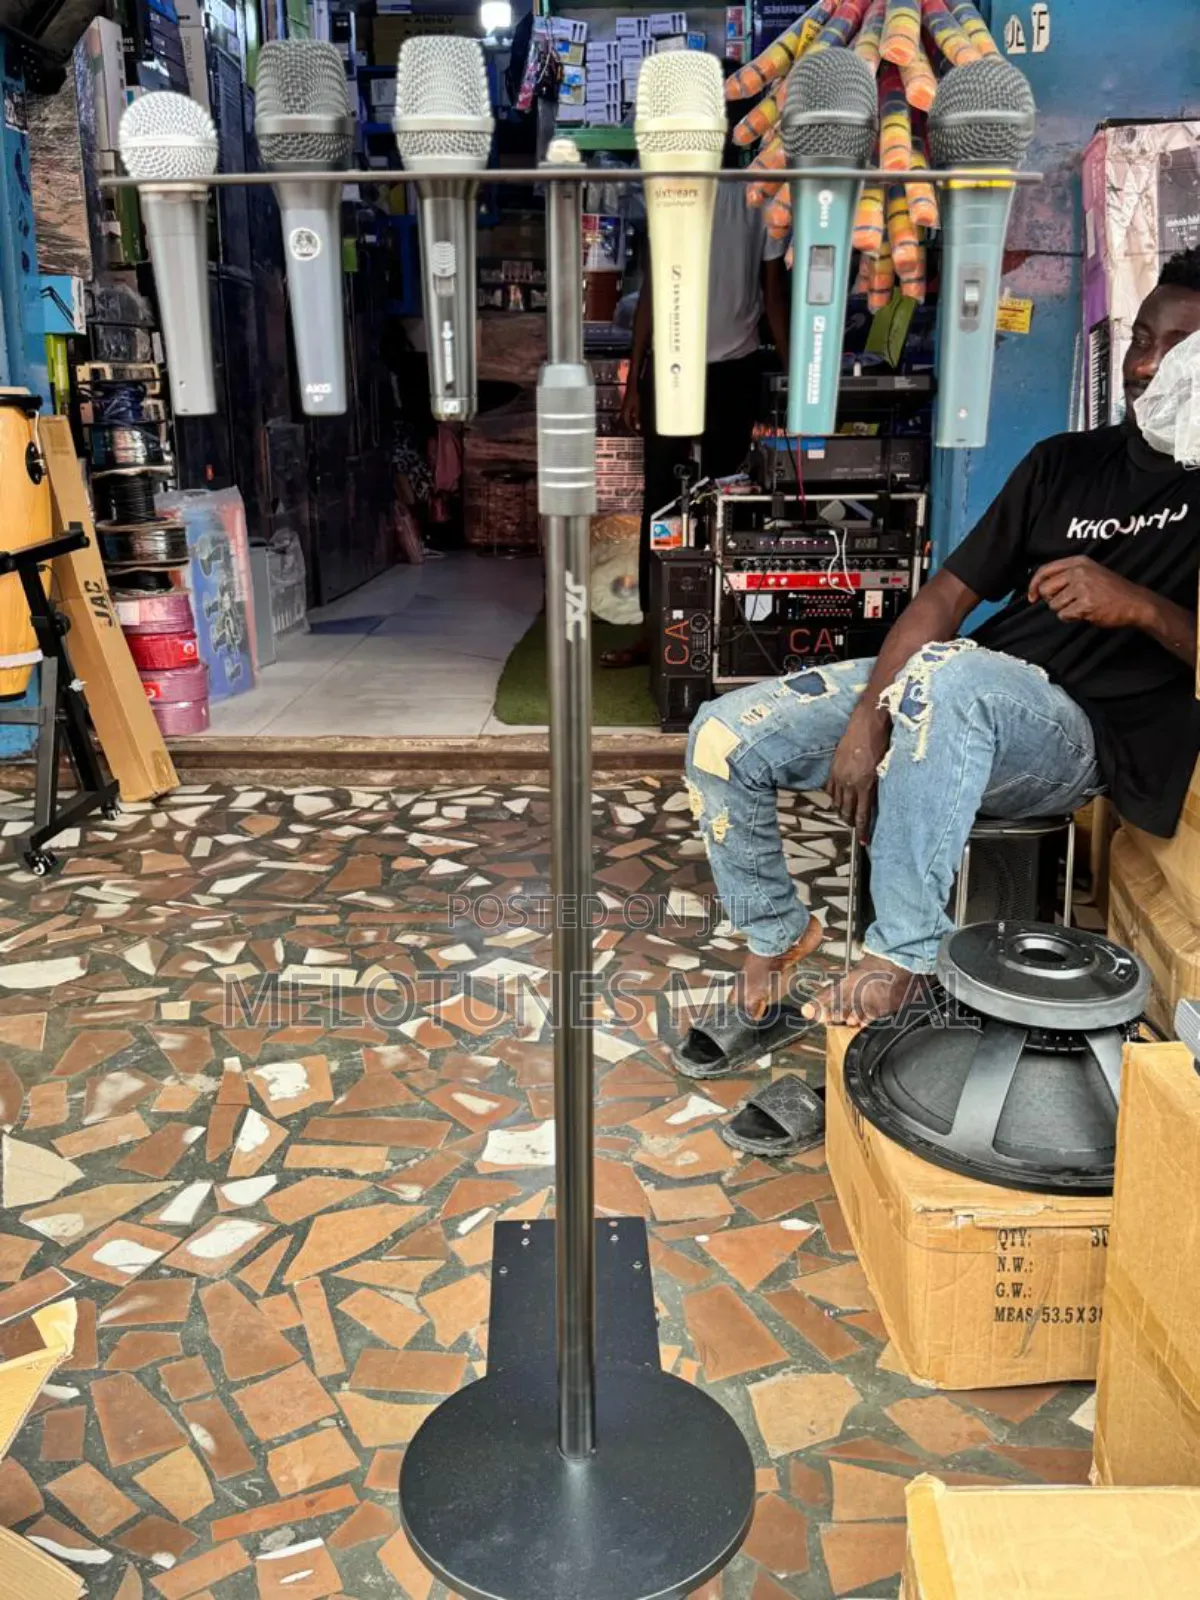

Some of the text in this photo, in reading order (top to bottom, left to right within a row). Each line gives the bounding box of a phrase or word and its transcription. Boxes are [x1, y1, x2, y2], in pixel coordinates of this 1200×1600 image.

[763, 5, 806, 14] SHURE
[664, 620, 690, 665] CA
[789, 628, 835, 654] CA
